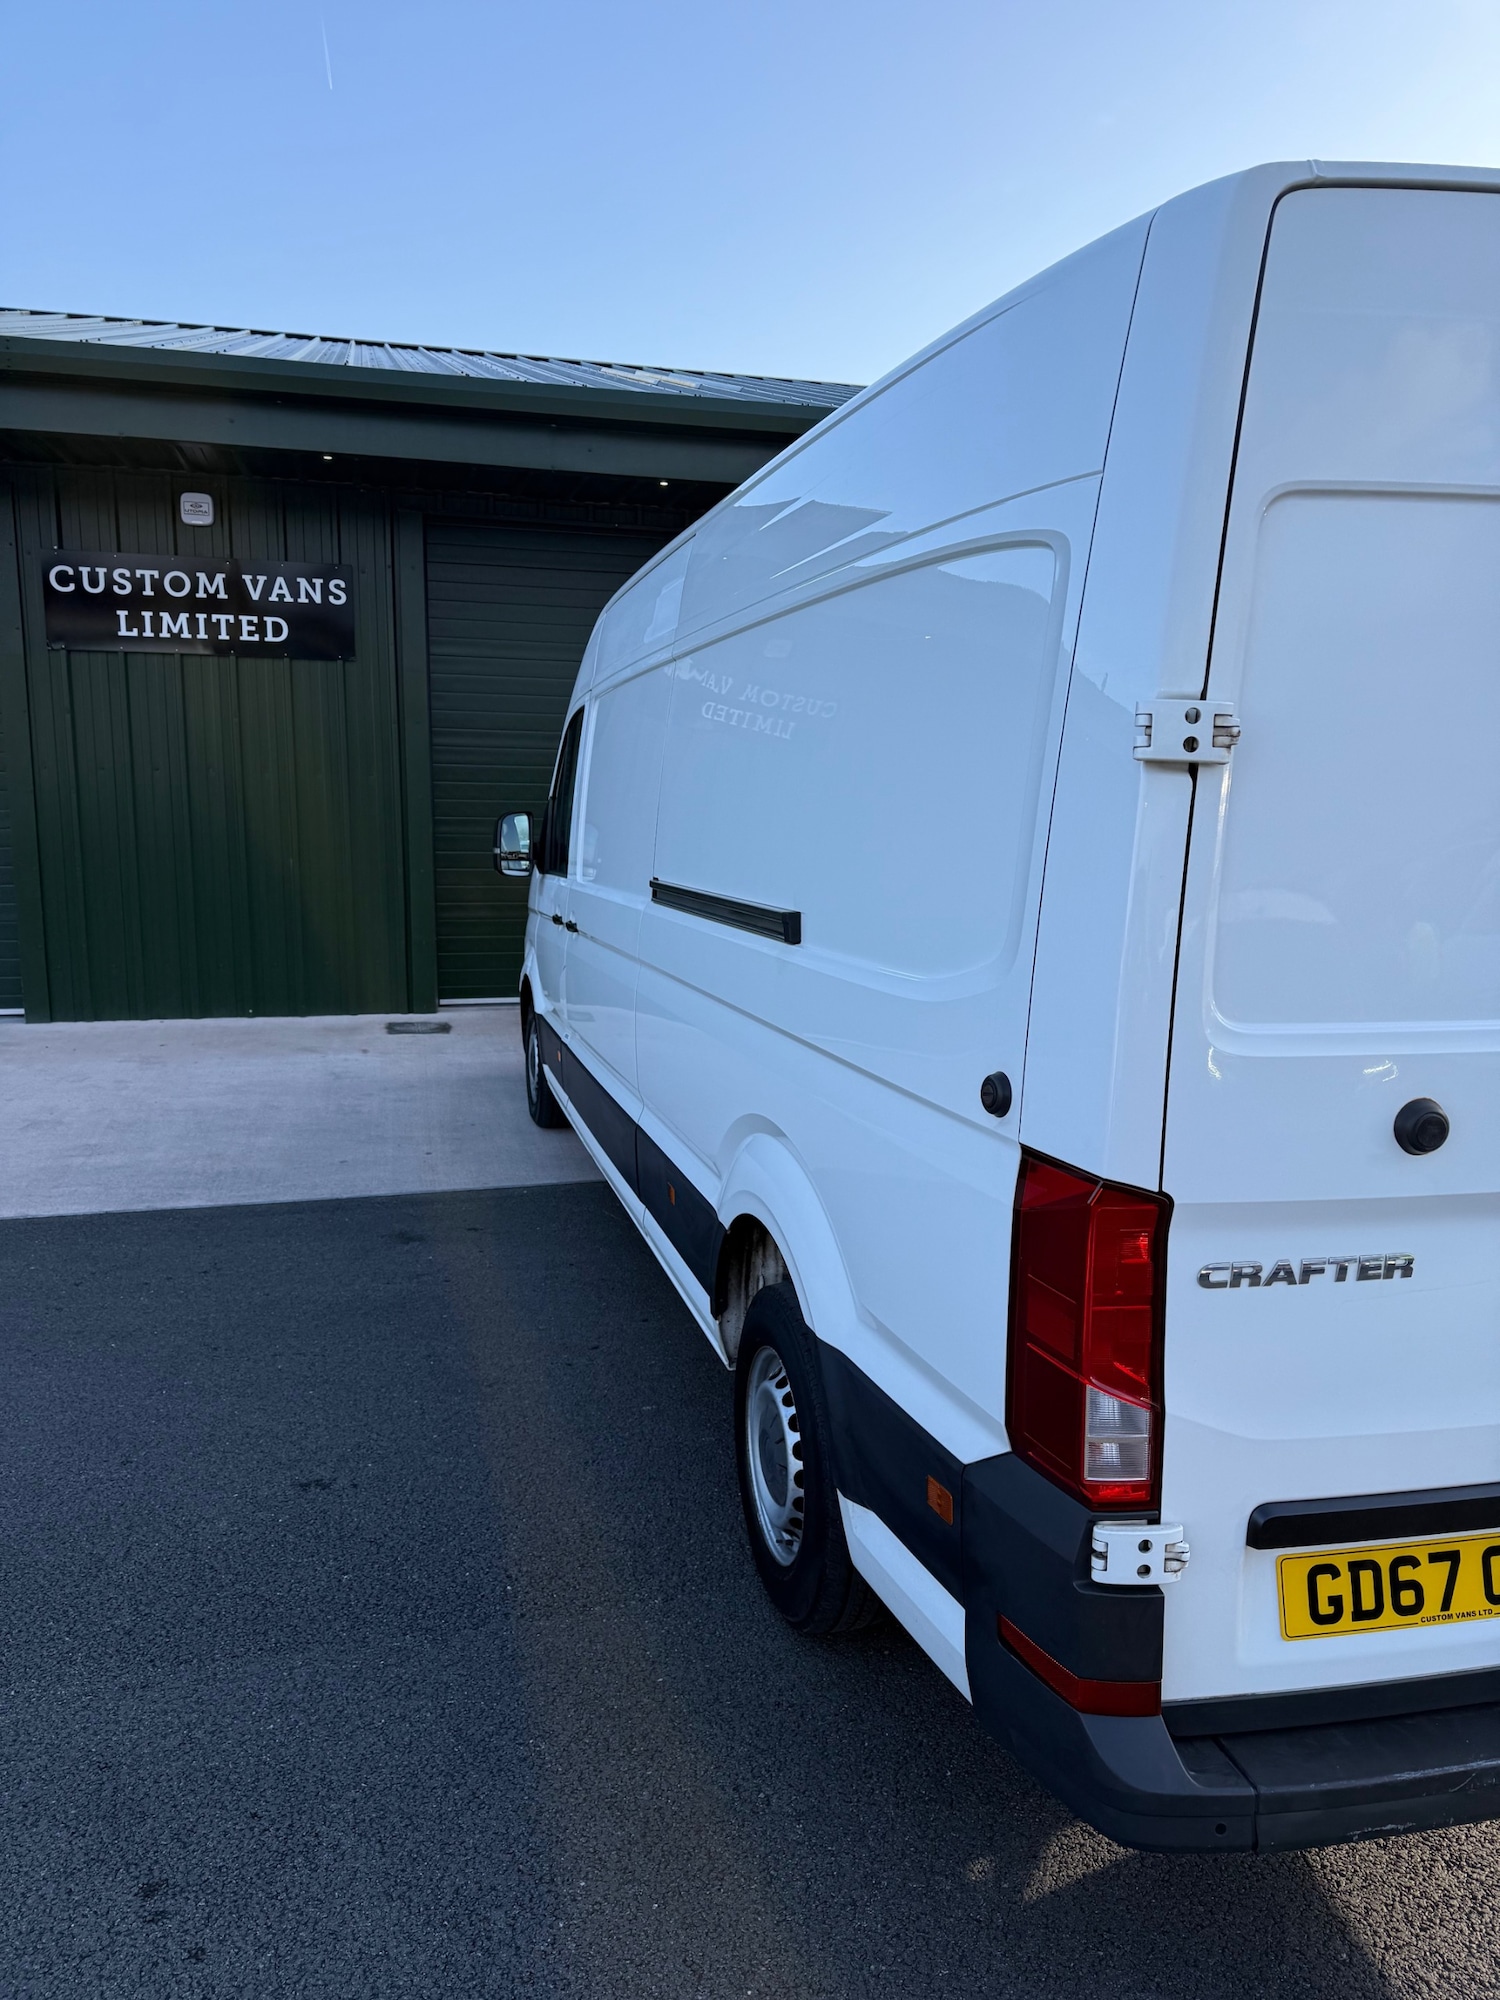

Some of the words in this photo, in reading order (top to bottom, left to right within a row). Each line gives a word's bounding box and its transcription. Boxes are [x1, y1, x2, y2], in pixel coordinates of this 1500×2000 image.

[49, 564, 229, 600] CUSTOM
[242, 573, 348, 606] VANS
[116, 609, 290, 643] LIMITED
[1196, 1251, 1415, 1290] CRAFTER
[1307, 1549, 1461, 1626] GD67
[1420, 1613, 1454, 1623] CUSTOM
[1455, 1609, 1477, 1619] VANS
[1478, 1608, 1493, 1616] LTD
